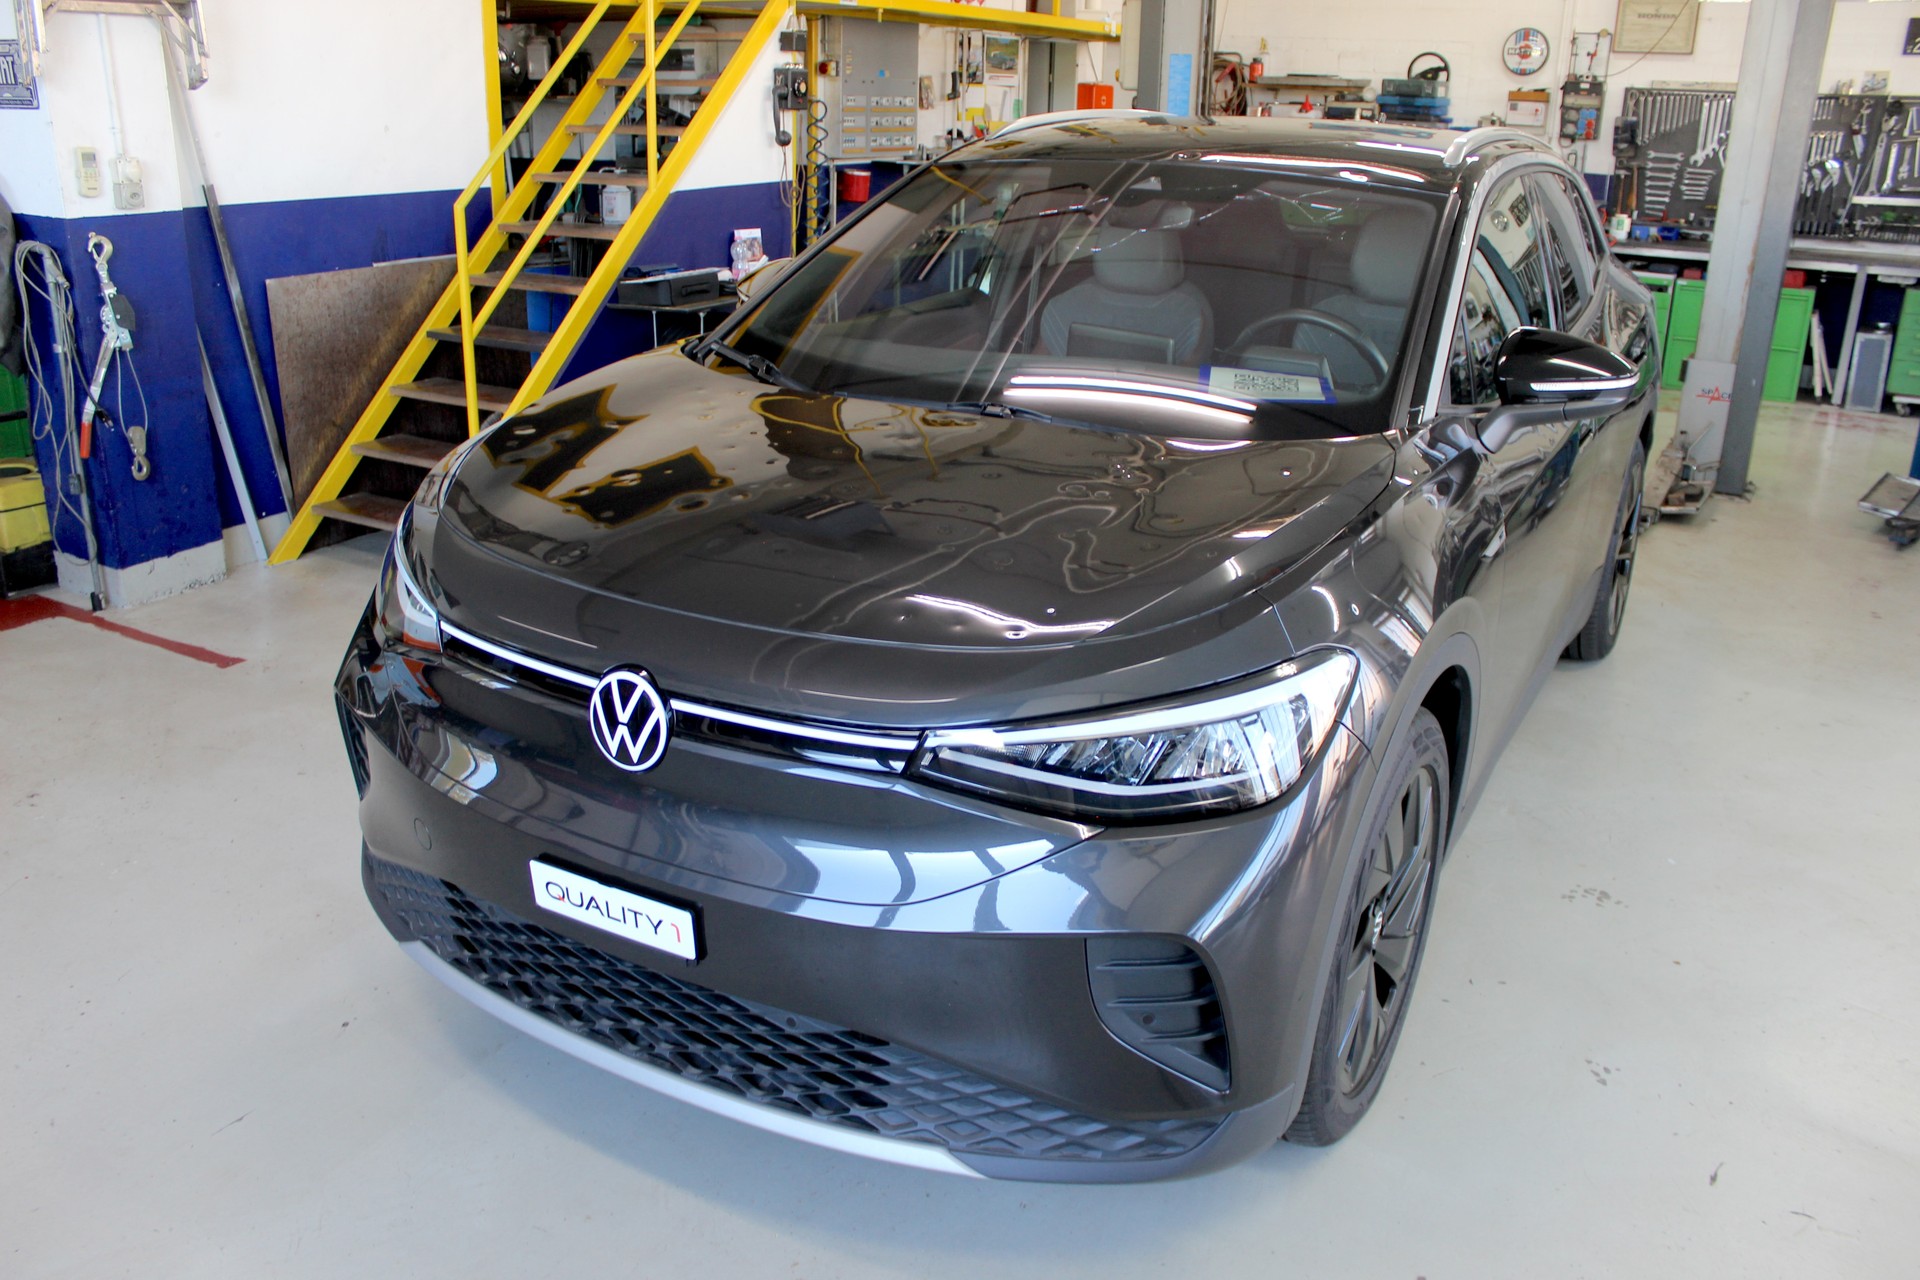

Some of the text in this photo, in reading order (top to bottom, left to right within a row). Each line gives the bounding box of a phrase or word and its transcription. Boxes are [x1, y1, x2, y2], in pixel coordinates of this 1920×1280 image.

[591, 672, 665, 769] VW
[545, 881, 681, 943] QUALITY 1
